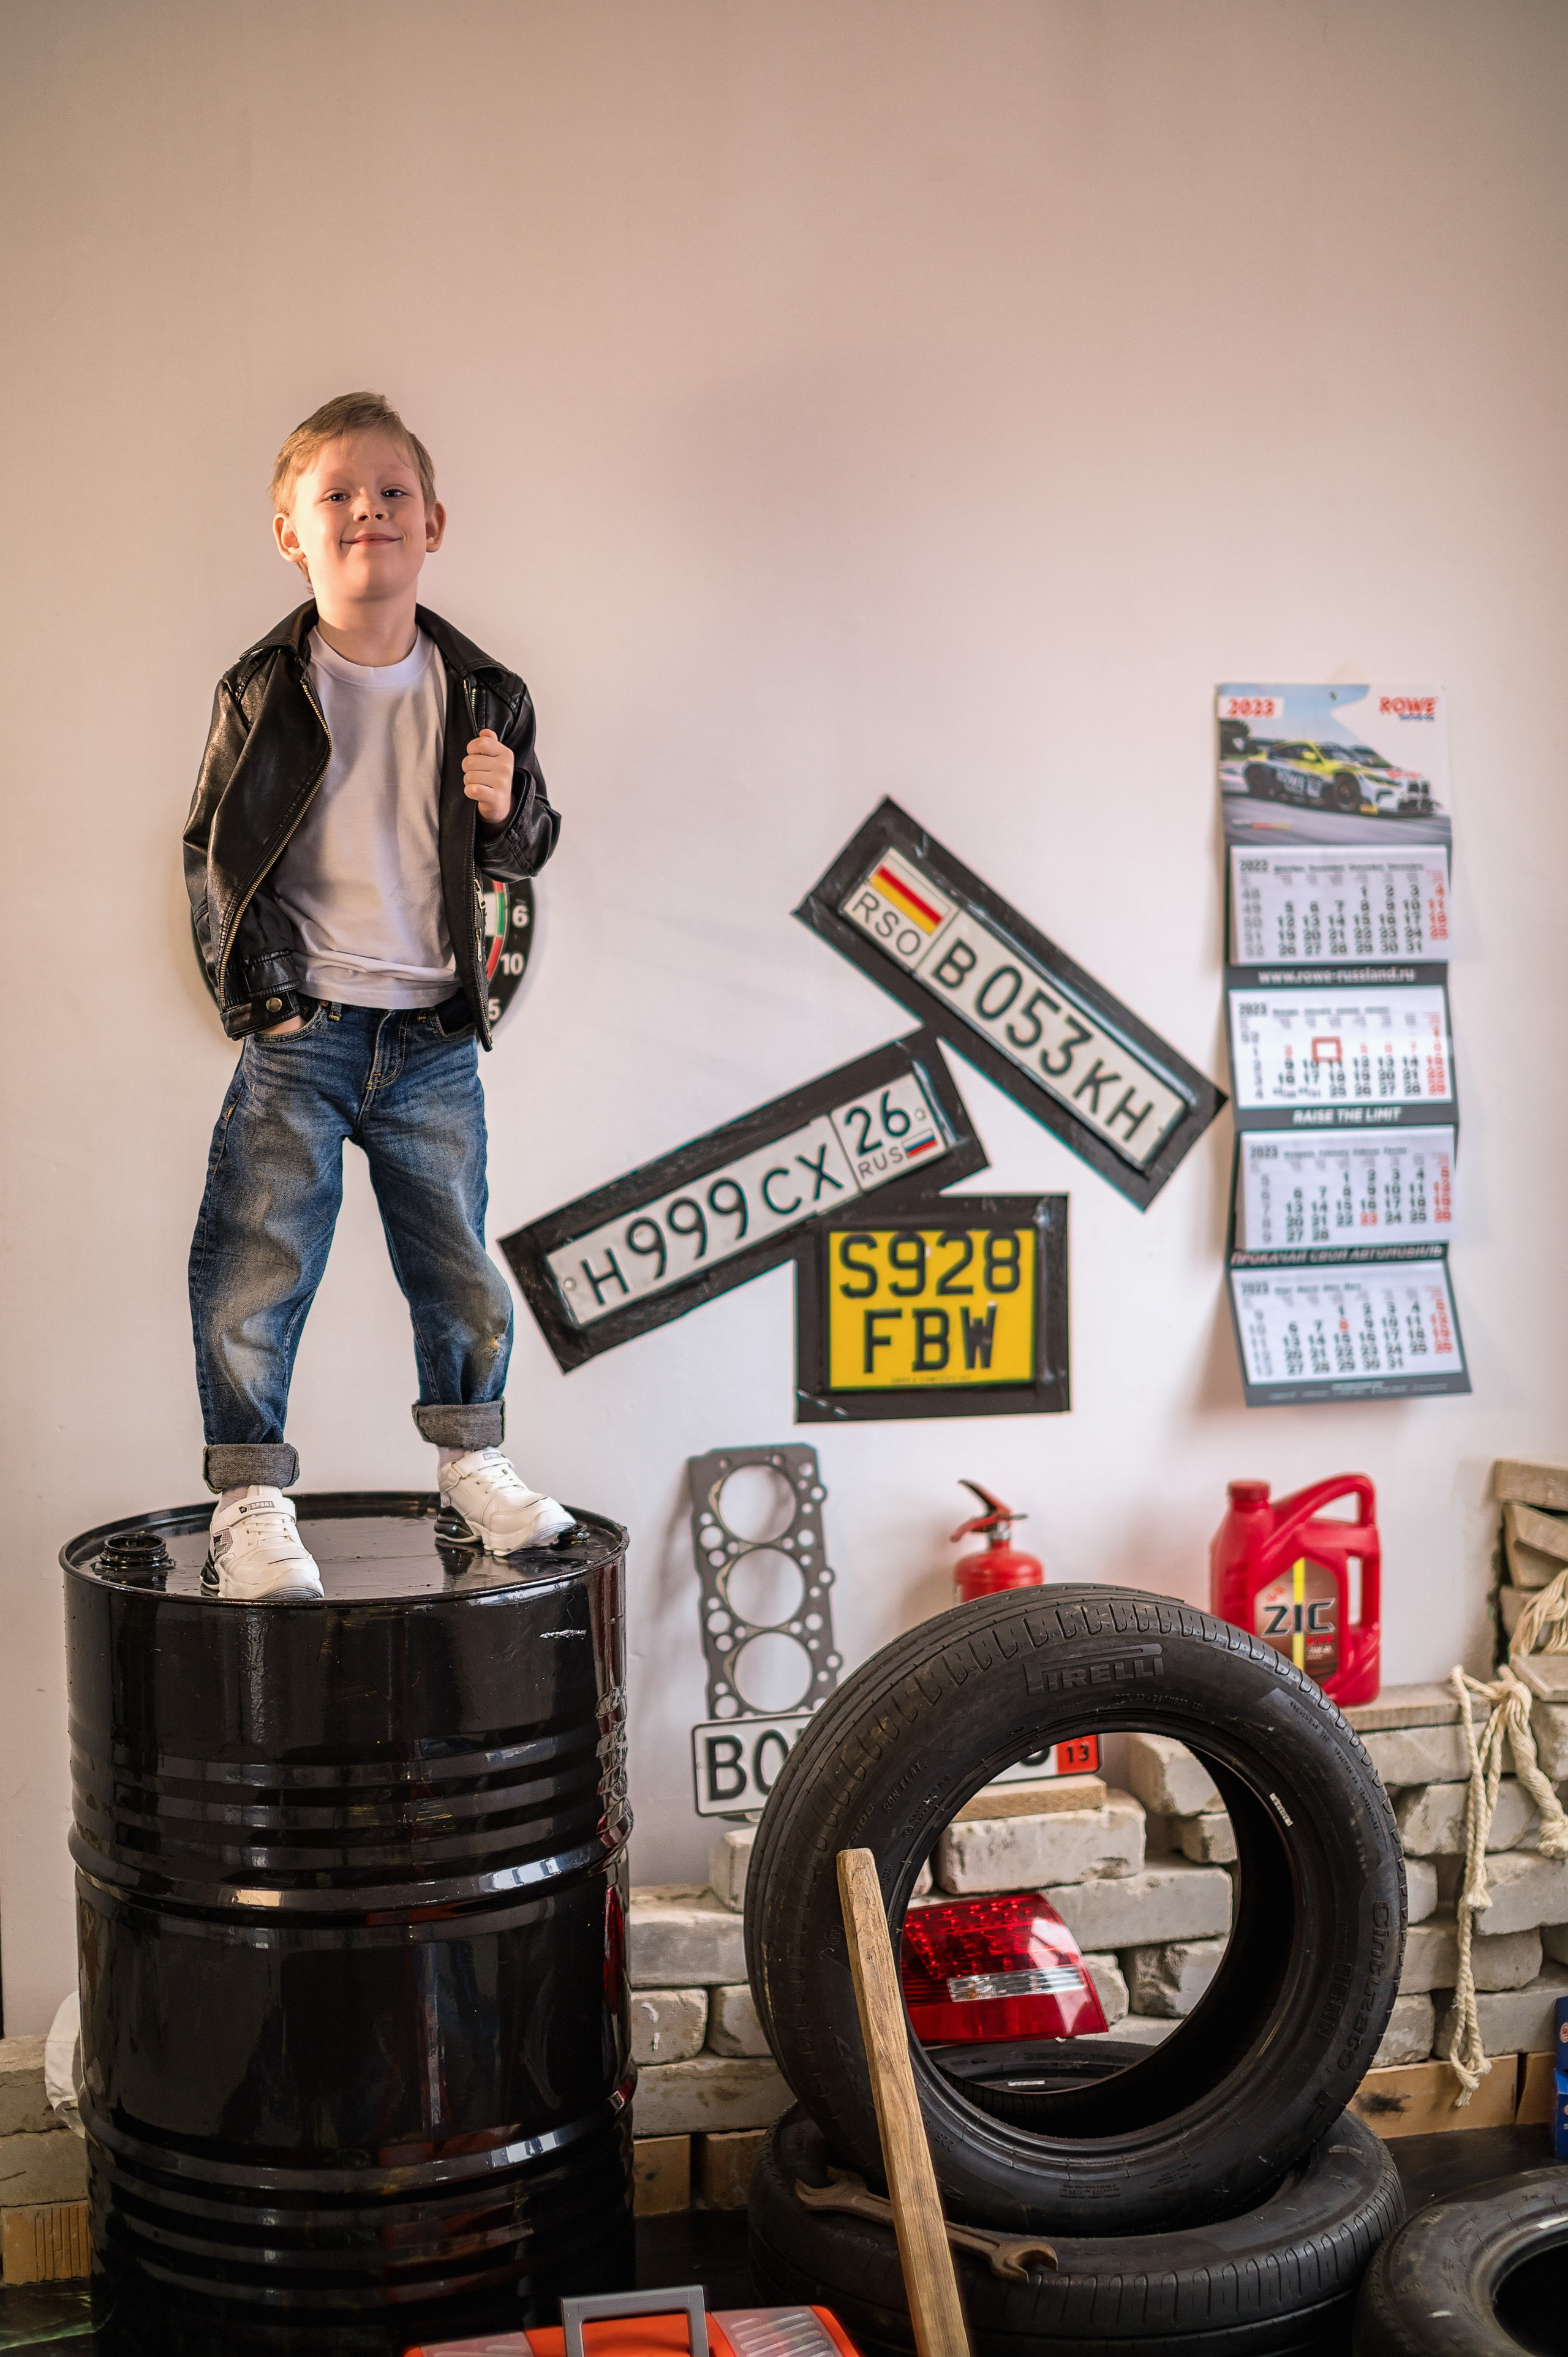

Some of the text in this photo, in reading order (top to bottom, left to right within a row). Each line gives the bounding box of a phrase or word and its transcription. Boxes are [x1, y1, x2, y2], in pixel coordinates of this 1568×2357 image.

[1227, 698, 1275, 717] 2023
[1379, 697, 1436, 715] ROWE
[513, 905, 530, 929] 6
[852, 891, 921, 957] RSO
[500, 952, 524, 976] 10
[931, 938, 1155, 1141] B053KH
[845, 1090, 911, 1156] 26
[1292, 1106, 1401, 1126] RAISE THE LIMIT
[858, 1147, 903, 1180] RUS
[581, 1144, 843, 1305] H999CX
[839, 1229, 1021, 1299] S928
[863, 1305, 998, 1375] FBW
[1262, 1597, 1336, 1637] ZIC
[1023, 1643, 1164, 1695] PIRELLI
[1066, 1743, 1090, 1763] 13
[1338, 1901, 1391, 2072] Cinturato
